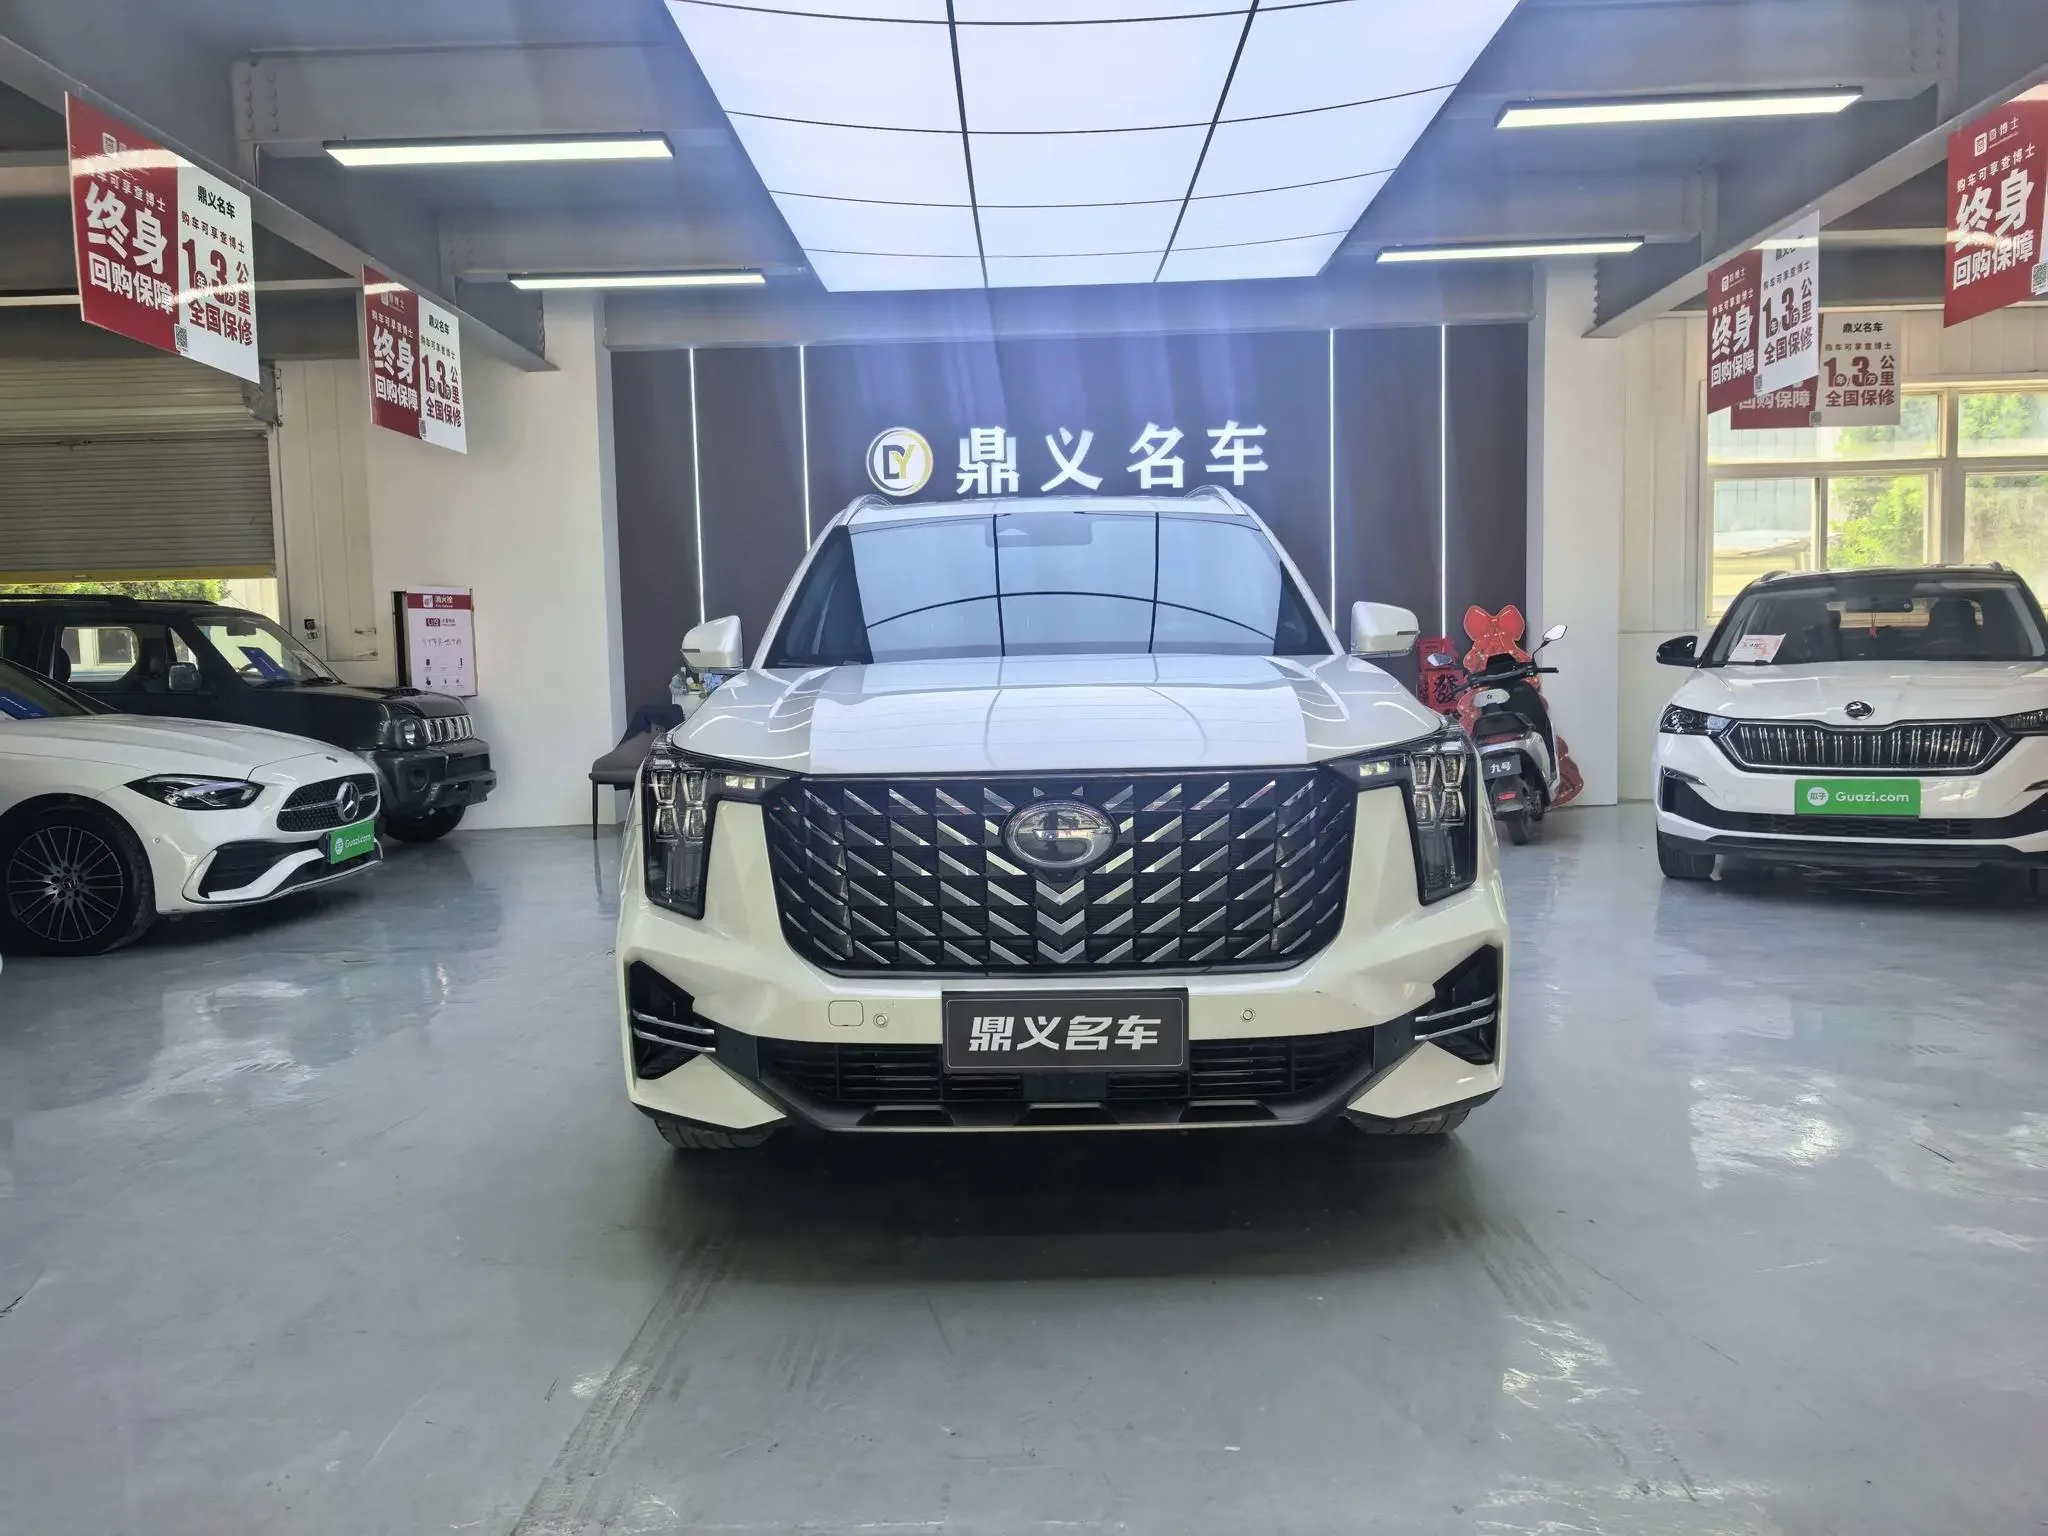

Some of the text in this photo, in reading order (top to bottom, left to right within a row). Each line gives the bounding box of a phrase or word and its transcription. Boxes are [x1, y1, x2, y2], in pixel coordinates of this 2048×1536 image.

[1957, 143, 2036, 193] 购车可享查博士
[92, 166, 166, 213] 车可享查博士
[197, 185, 236, 219] 鼎义名车
[1955, 168, 2034, 253] 终身
[85, 181, 168, 275] 终身
[181, 210, 245, 255] 购车可享查博士
[1952, 229, 2034, 291] 回购保障
[88, 251, 174, 315] 回购保障
[188, 301, 253, 346] 全国保修
[428, 314, 450, 336] 鼎义名车
[1711, 305, 1754, 360] 终身
[1842, 322, 1884, 333] 鼎义名车
[372, 324, 415, 384] 终身
[1764, 325, 1813, 367] 全国保修
[1711, 348, 1755, 388] 回购保障
[374, 374, 419, 412] 回购保障
[426, 396, 462, 428] 全国保修
[1825, 390, 1896, 408] 全国保修
[956, 419, 1269, 495] 鼎义名车
[1490, 761, 1512, 774] 九号
[1835, 791, 1910, 802] Guazi.com
[345, 833, 372, 849] Guazi.com
[968, 1014, 1162, 1052] 鼎义名车
